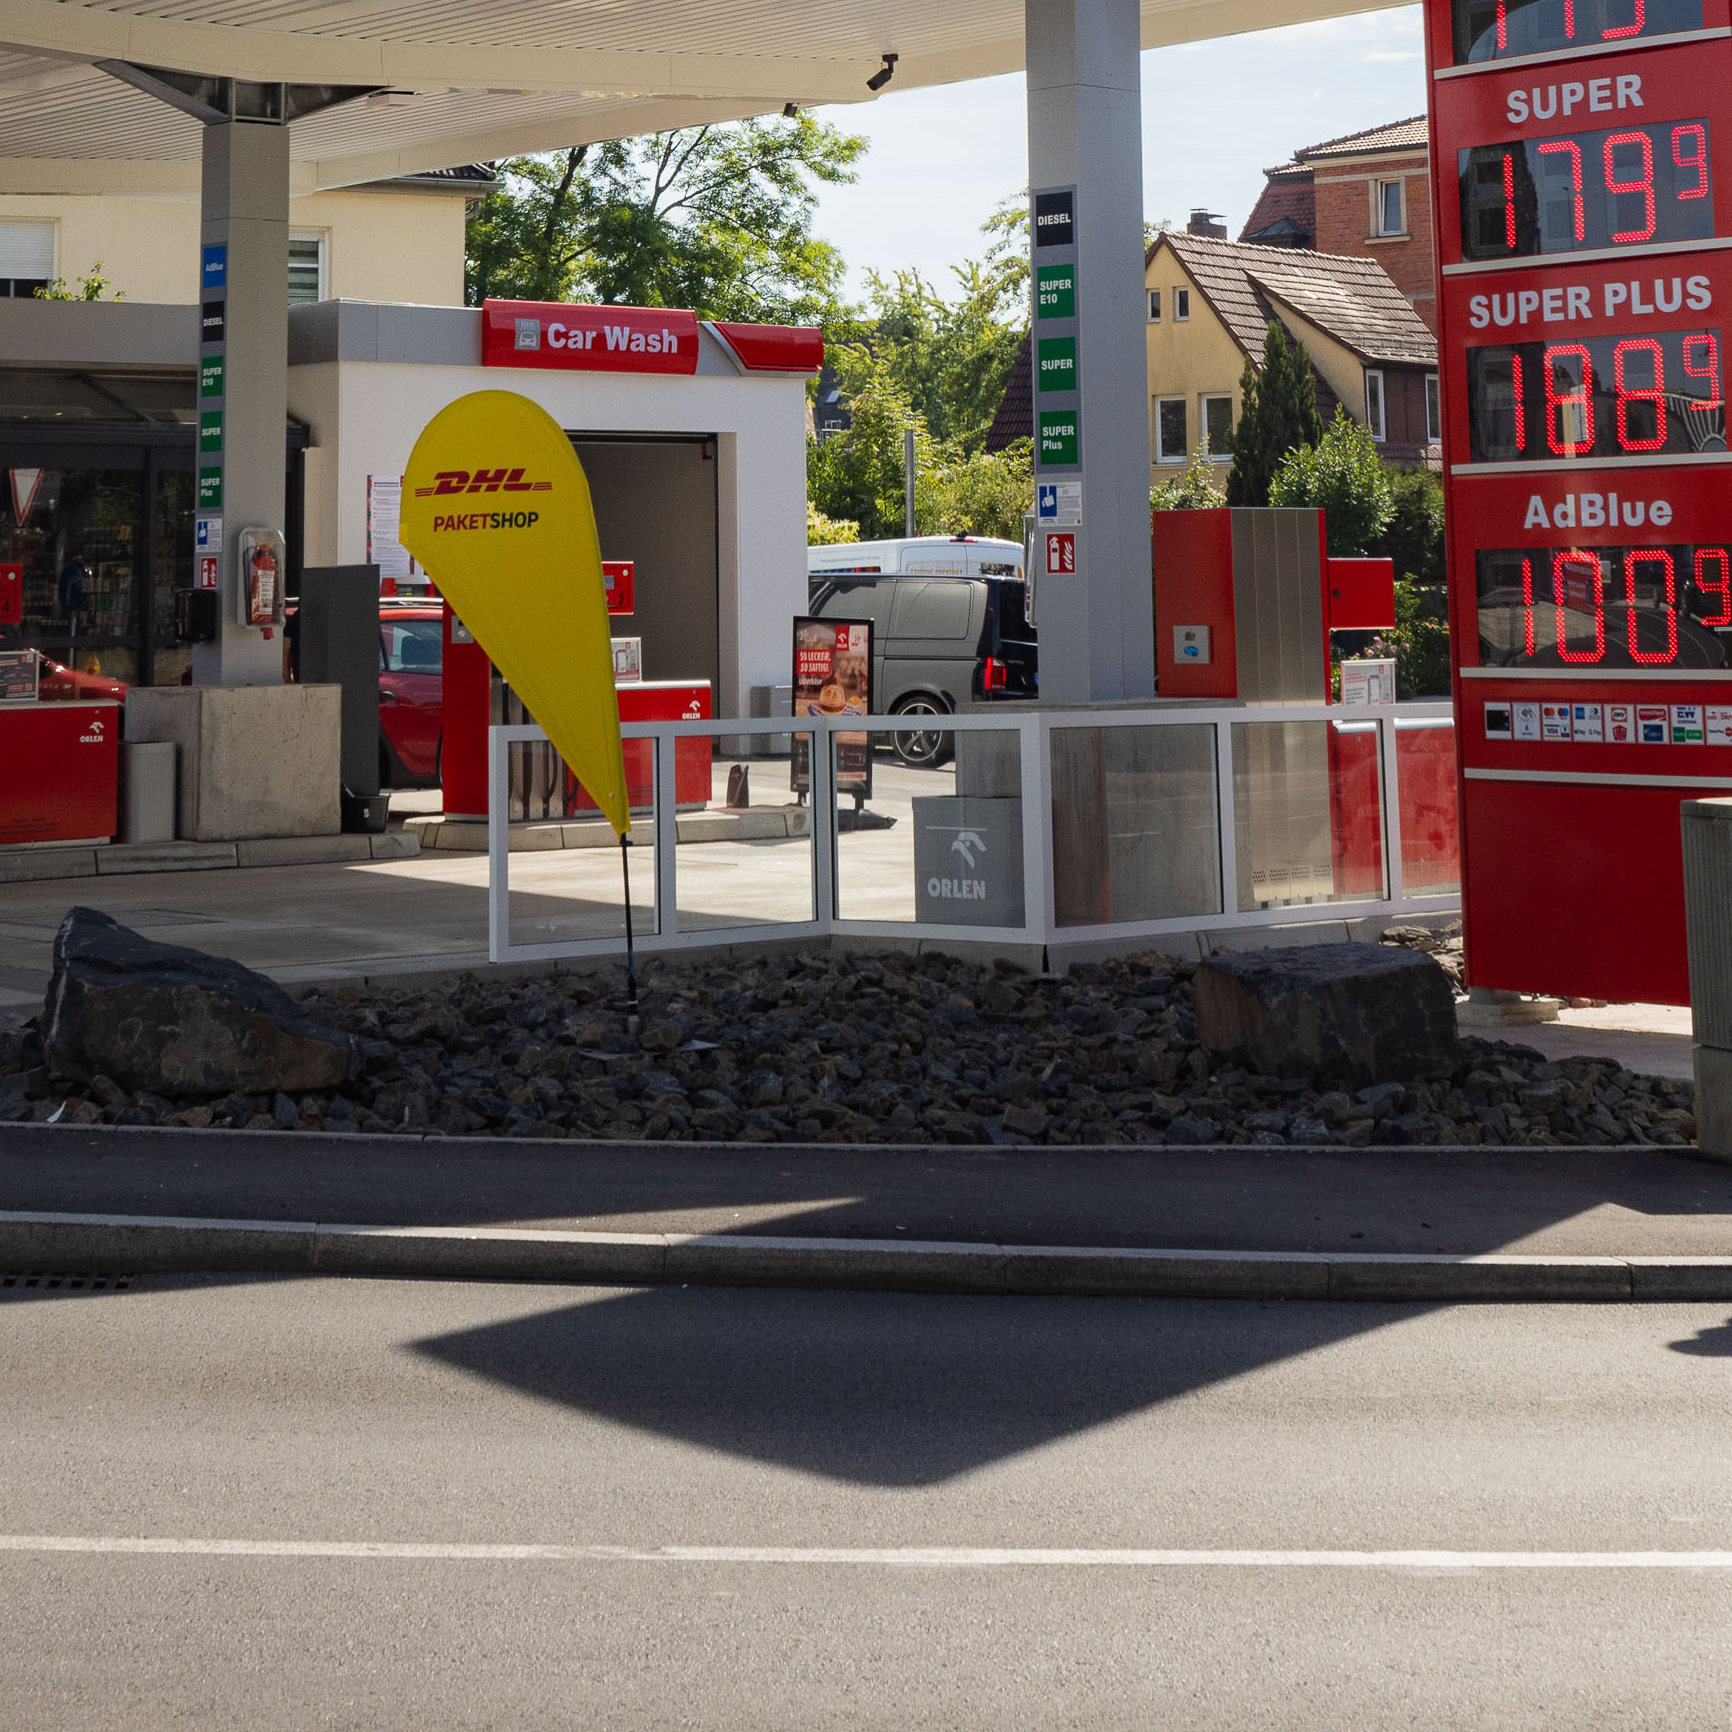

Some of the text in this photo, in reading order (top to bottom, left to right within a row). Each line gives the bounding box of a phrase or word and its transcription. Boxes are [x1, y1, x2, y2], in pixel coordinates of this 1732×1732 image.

[1506, 74, 1644, 124] SUPER
[1037, 213, 1072, 226] DIESEL
[1039, 279, 1072, 291] SUPER
[1040, 293, 1058, 304] E10
[1469, 275, 1712, 328] SUPER PLUS
[203, 316, 223, 327] DIESEL
[547, 322, 678, 354] Car Wash
[1041, 358, 1073, 370] SUPER
[202, 366, 222, 376] SUPER
[202, 377, 214, 386] E10
[201, 426, 221, 436] SUPER
[1042, 425, 1075, 437] SUPER
[1042, 440, 1062, 450] Plus
[200, 477, 220, 487] SUPER
[432, 468, 535, 496] DHL
[200, 487, 213, 497] Plus
[1524, 492, 1673, 529] AdBlue
[433, 511, 539, 532] PAKETSHOP
[800, 651, 831, 662] SO LECKER,
[800, 663, 808, 672] SO
[682, 712, 701, 720] ORLEN
[79, 735, 104, 743] ORLEN
[927, 877, 986, 900] ORLEN
